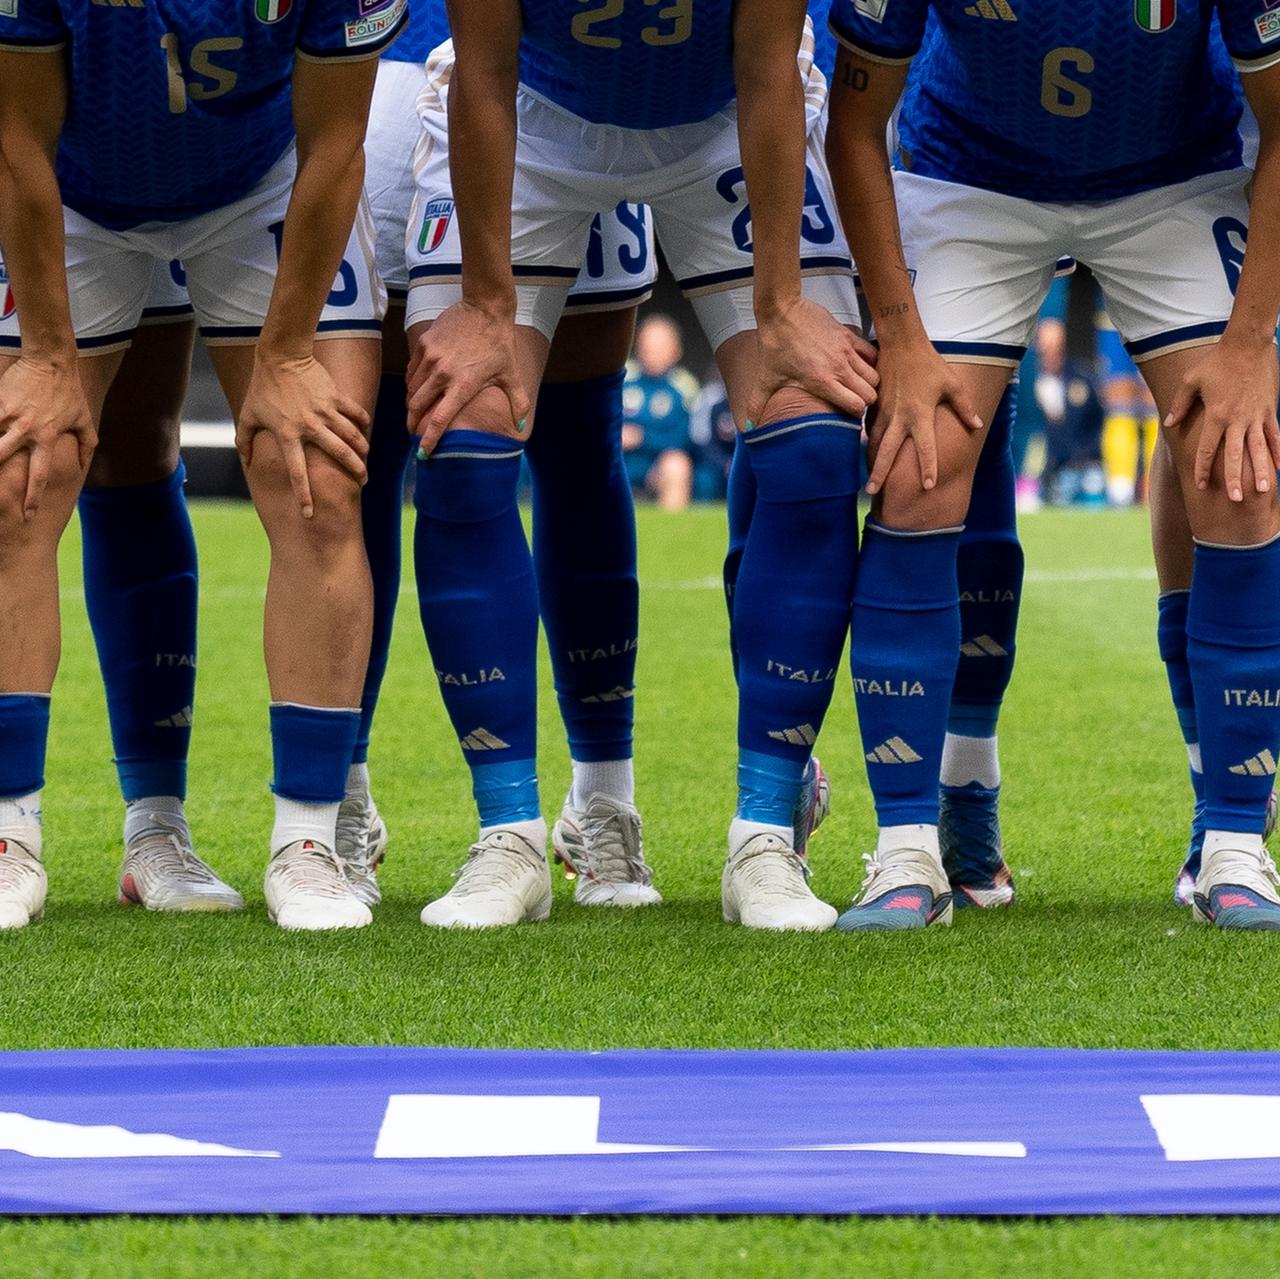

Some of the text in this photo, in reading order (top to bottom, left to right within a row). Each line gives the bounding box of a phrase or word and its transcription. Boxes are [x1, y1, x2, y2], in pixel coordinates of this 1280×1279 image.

[159, 31, 244, 114] 15
[841, 63, 869, 93] 10
[1040, 46, 1096, 118] 6
[427, 199, 454, 216] ITALIA
[567, 637, 638, 664] ITALIA
[853, 677, 926, 697] ITALIA
